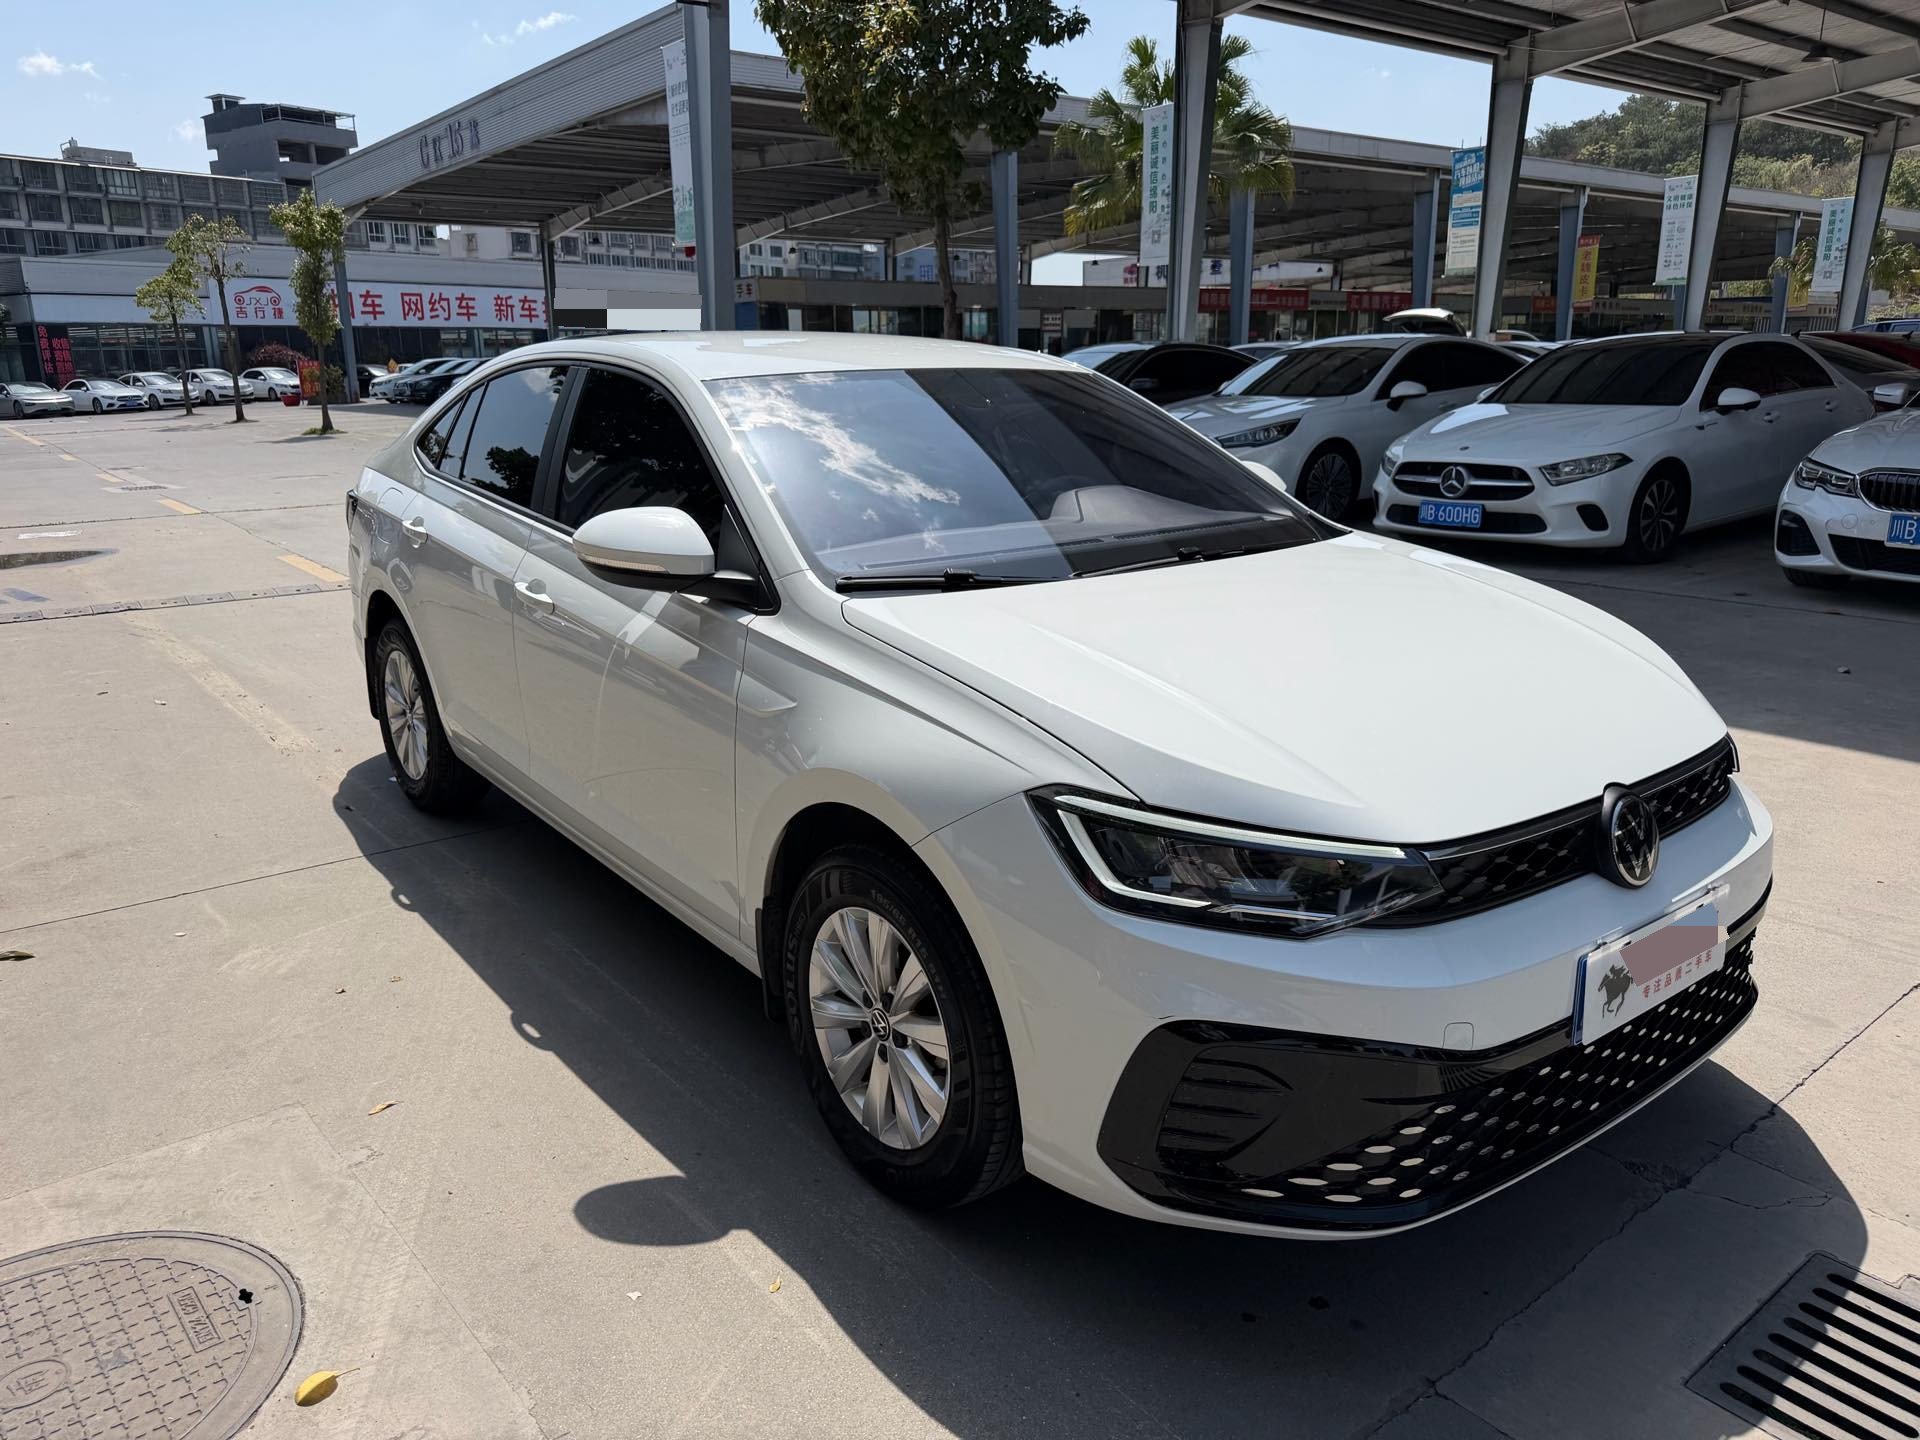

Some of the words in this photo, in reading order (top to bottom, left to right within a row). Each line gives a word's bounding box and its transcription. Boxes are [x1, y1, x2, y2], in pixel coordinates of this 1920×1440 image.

[1149, 126, 1160, 215] 美丽诚信绵阳
[235, 306, 284, 320] 吉行捷
[400, 291, 478, 322] 网约车
[494, 294, 547, 323] 新车
